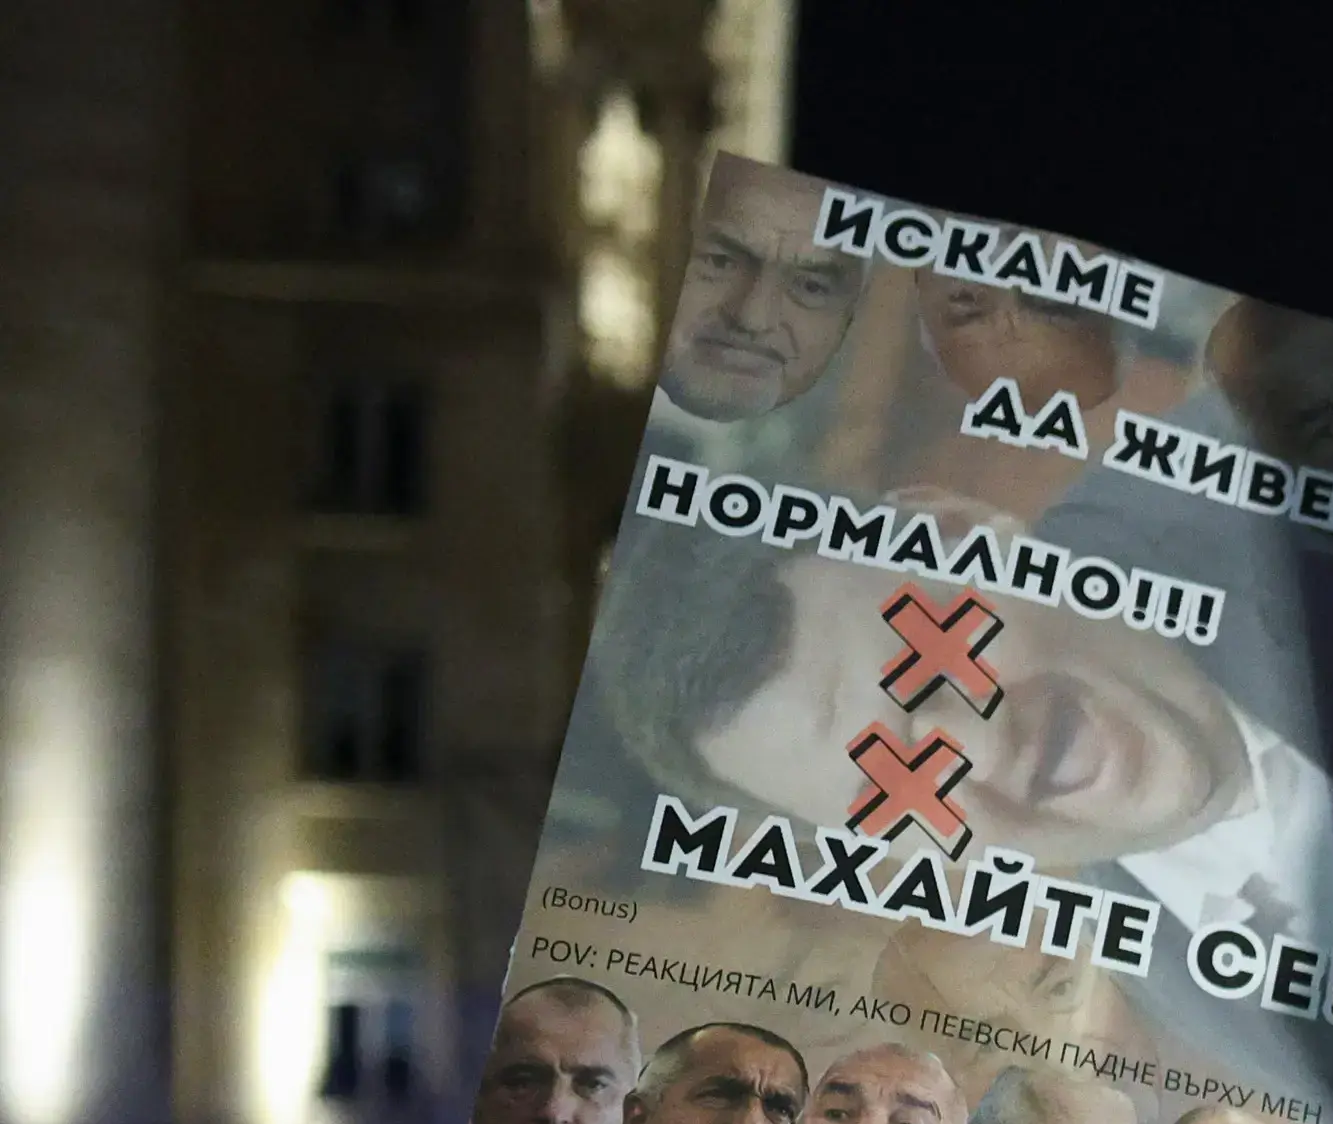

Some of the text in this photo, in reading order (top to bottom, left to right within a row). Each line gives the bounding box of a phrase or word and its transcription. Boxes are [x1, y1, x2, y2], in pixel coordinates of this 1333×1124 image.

[814, 188, 1161, 328] ИСКАМЕ
[963, 379, 1086, 457] ДА
[636, 457, 1223, 644] НОРМАЛНО!!!
[541, 886, 639, 923] (Bonus)
[642, 796, 1160, 977] МАХАЙТЕ
[531, 936, 598, 969] POV:
[606, 948, 777, 1001] РЕАКЦИЯТА
[786, 981, 840, 1017] МИ,
[850, 995, 911, 1026] АКО
[919, 1009, 1051, 1061] ПЕЕВСКИ
[1059, 1042, 1157, 1086] ПАДНЕ
[1164, 1067, 1256, 1109] ВЪРХУ
